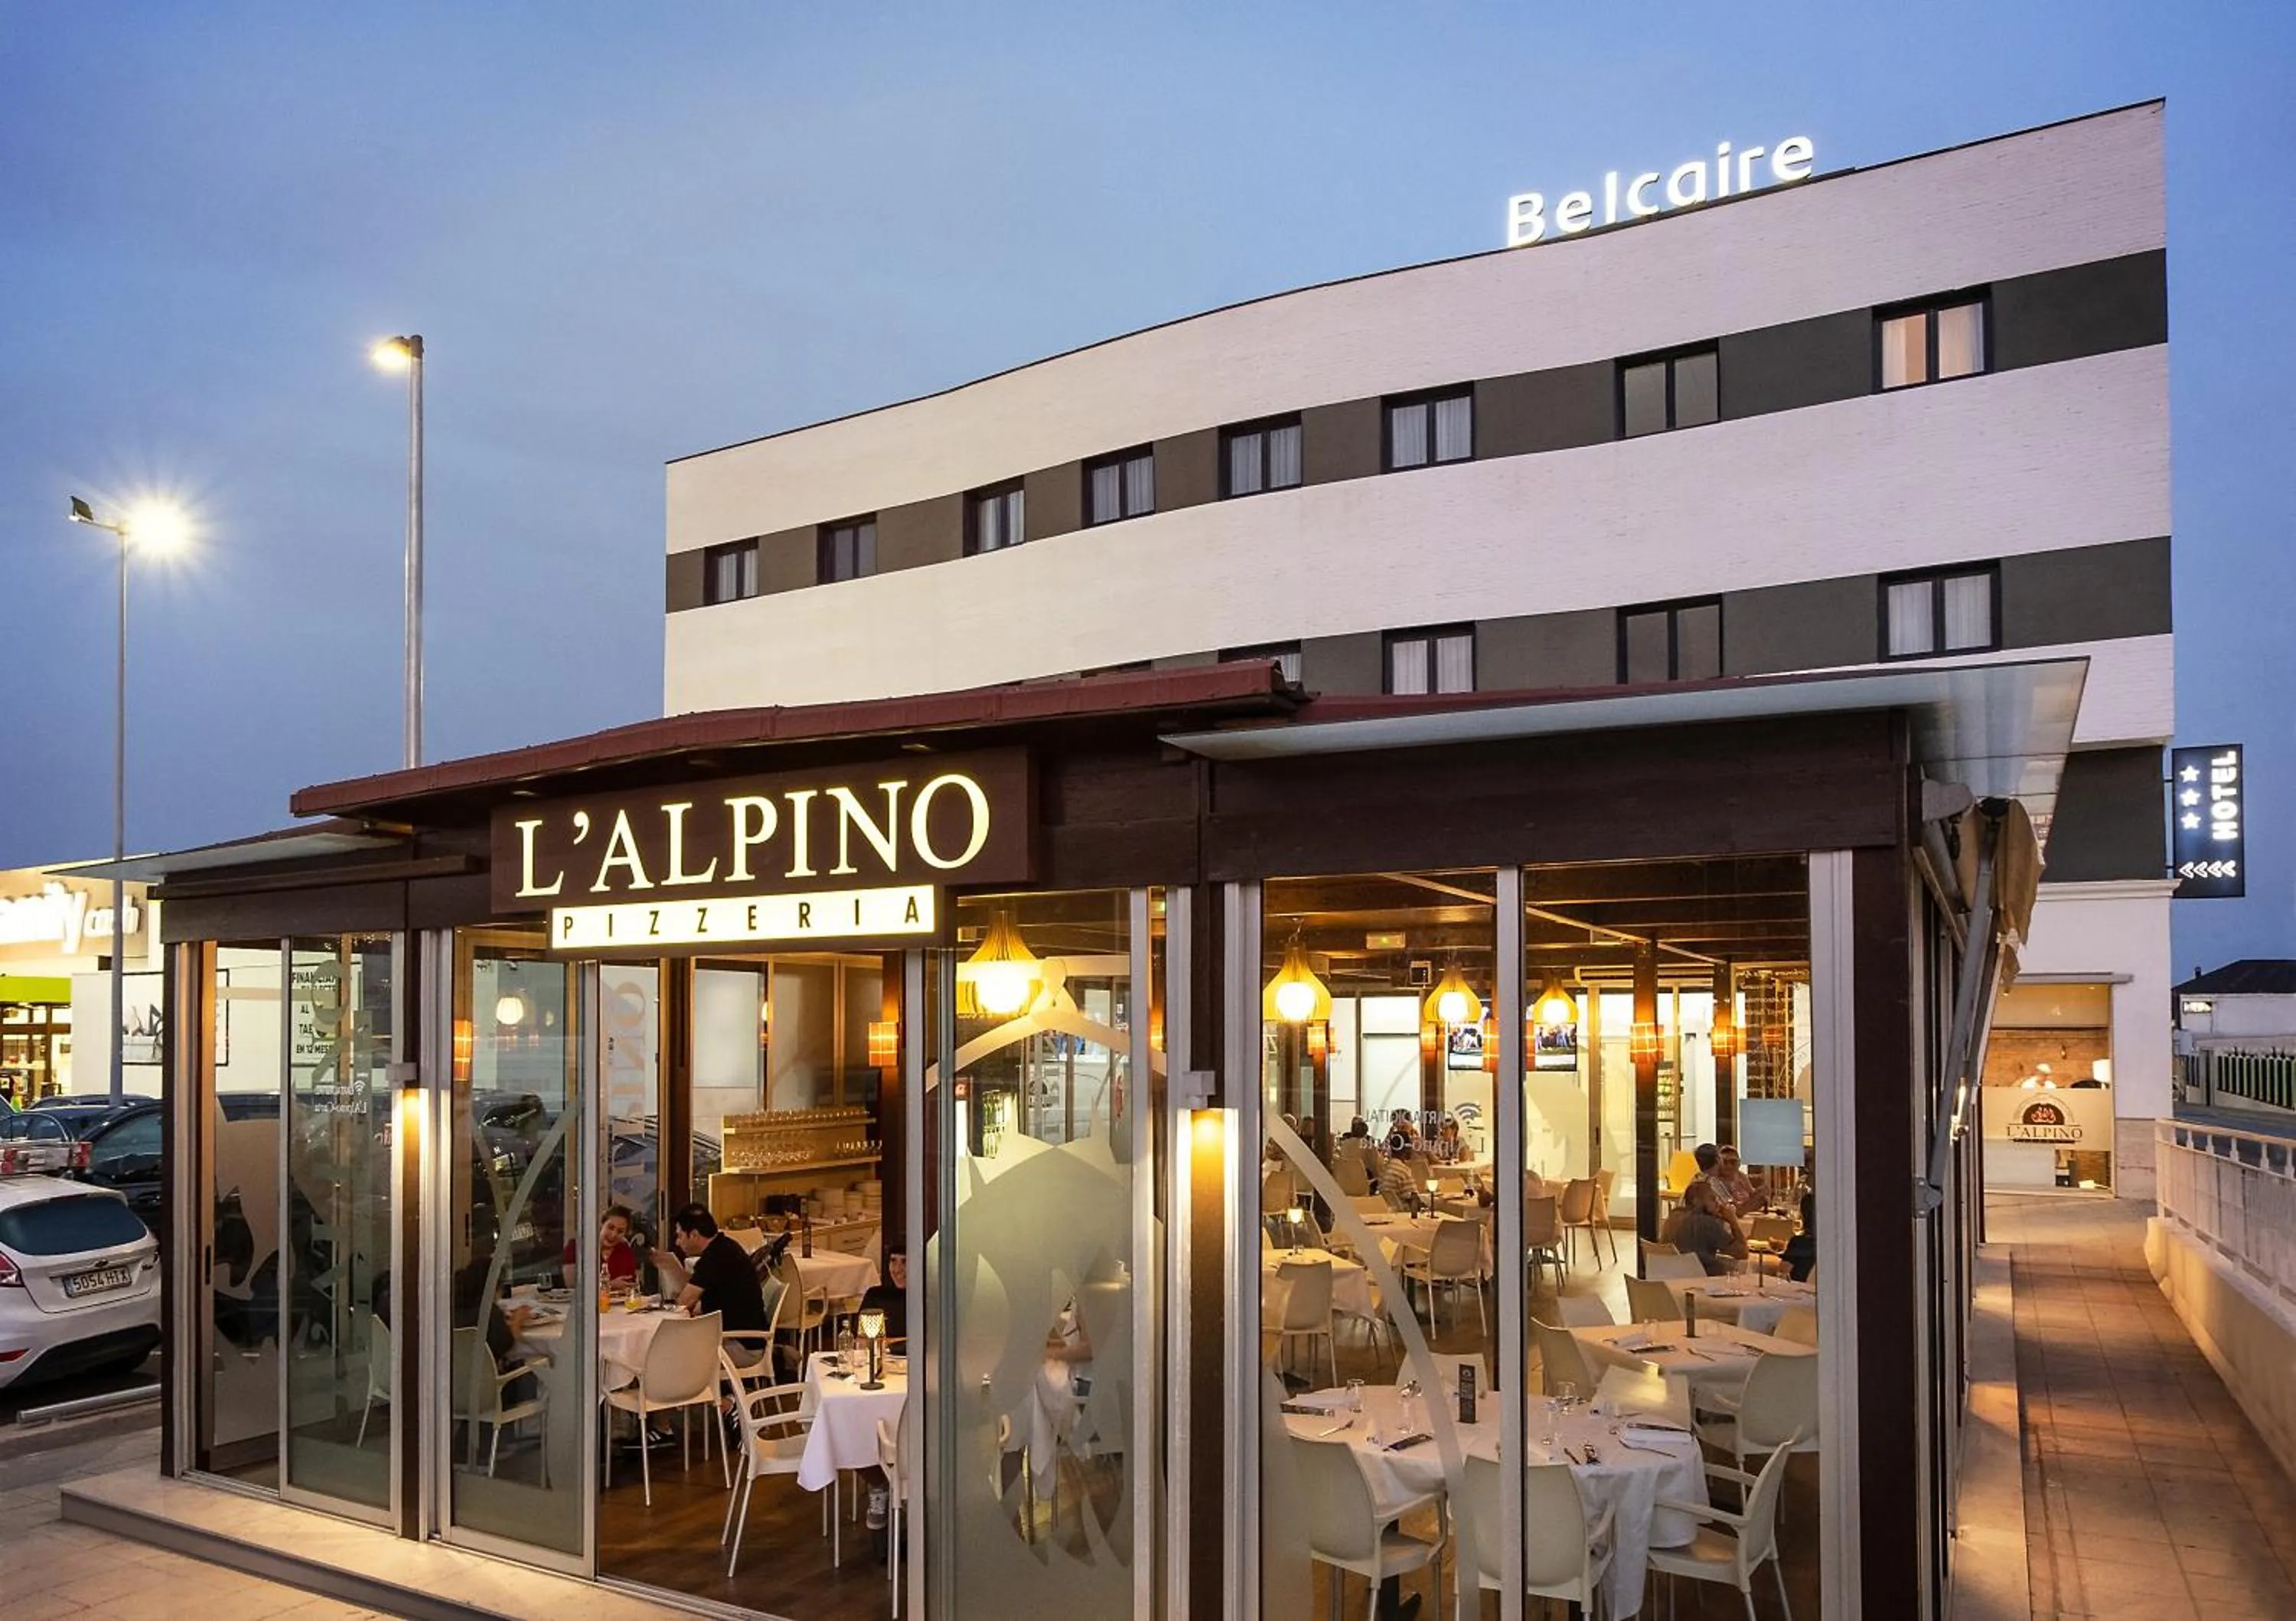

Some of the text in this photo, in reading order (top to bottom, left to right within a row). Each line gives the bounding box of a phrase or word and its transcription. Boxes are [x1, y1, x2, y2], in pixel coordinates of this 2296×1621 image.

[1507, 135, 1814, 248] Belcaire
[514, 774, 990, 898] L'ALPINO
[2210, 750, 2239, 840] HOTEL
[563, 895, 920, 940] PIZZERIA
[2007, 1125, 2083, 1140] L'ALPINO
